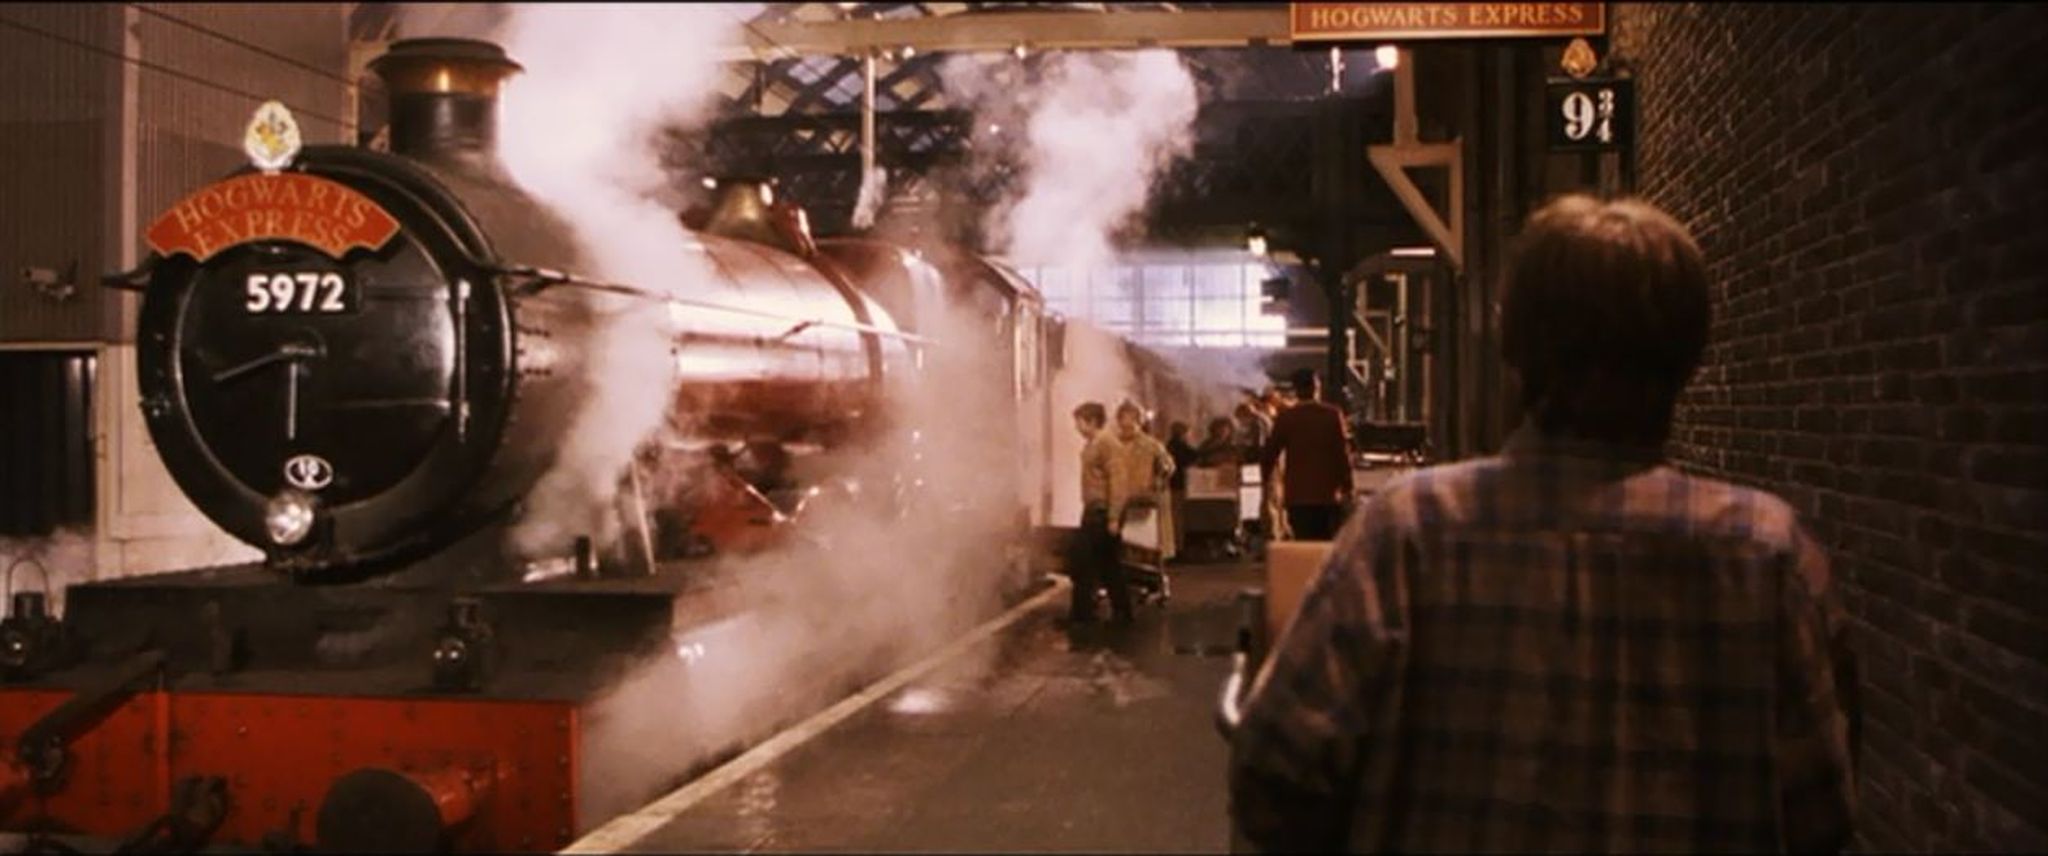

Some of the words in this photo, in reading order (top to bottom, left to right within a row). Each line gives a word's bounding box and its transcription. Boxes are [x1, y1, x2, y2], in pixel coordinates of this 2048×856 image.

[1311, 6, 1458, 28] HOGWARTS
[1469, 4, 1583, 25] EXPRESS
[174, 177, 371, 233] HOGWARTS
[193, 209, 351, 256] EXPRESS
[246, 273, 345, 313] 5972
